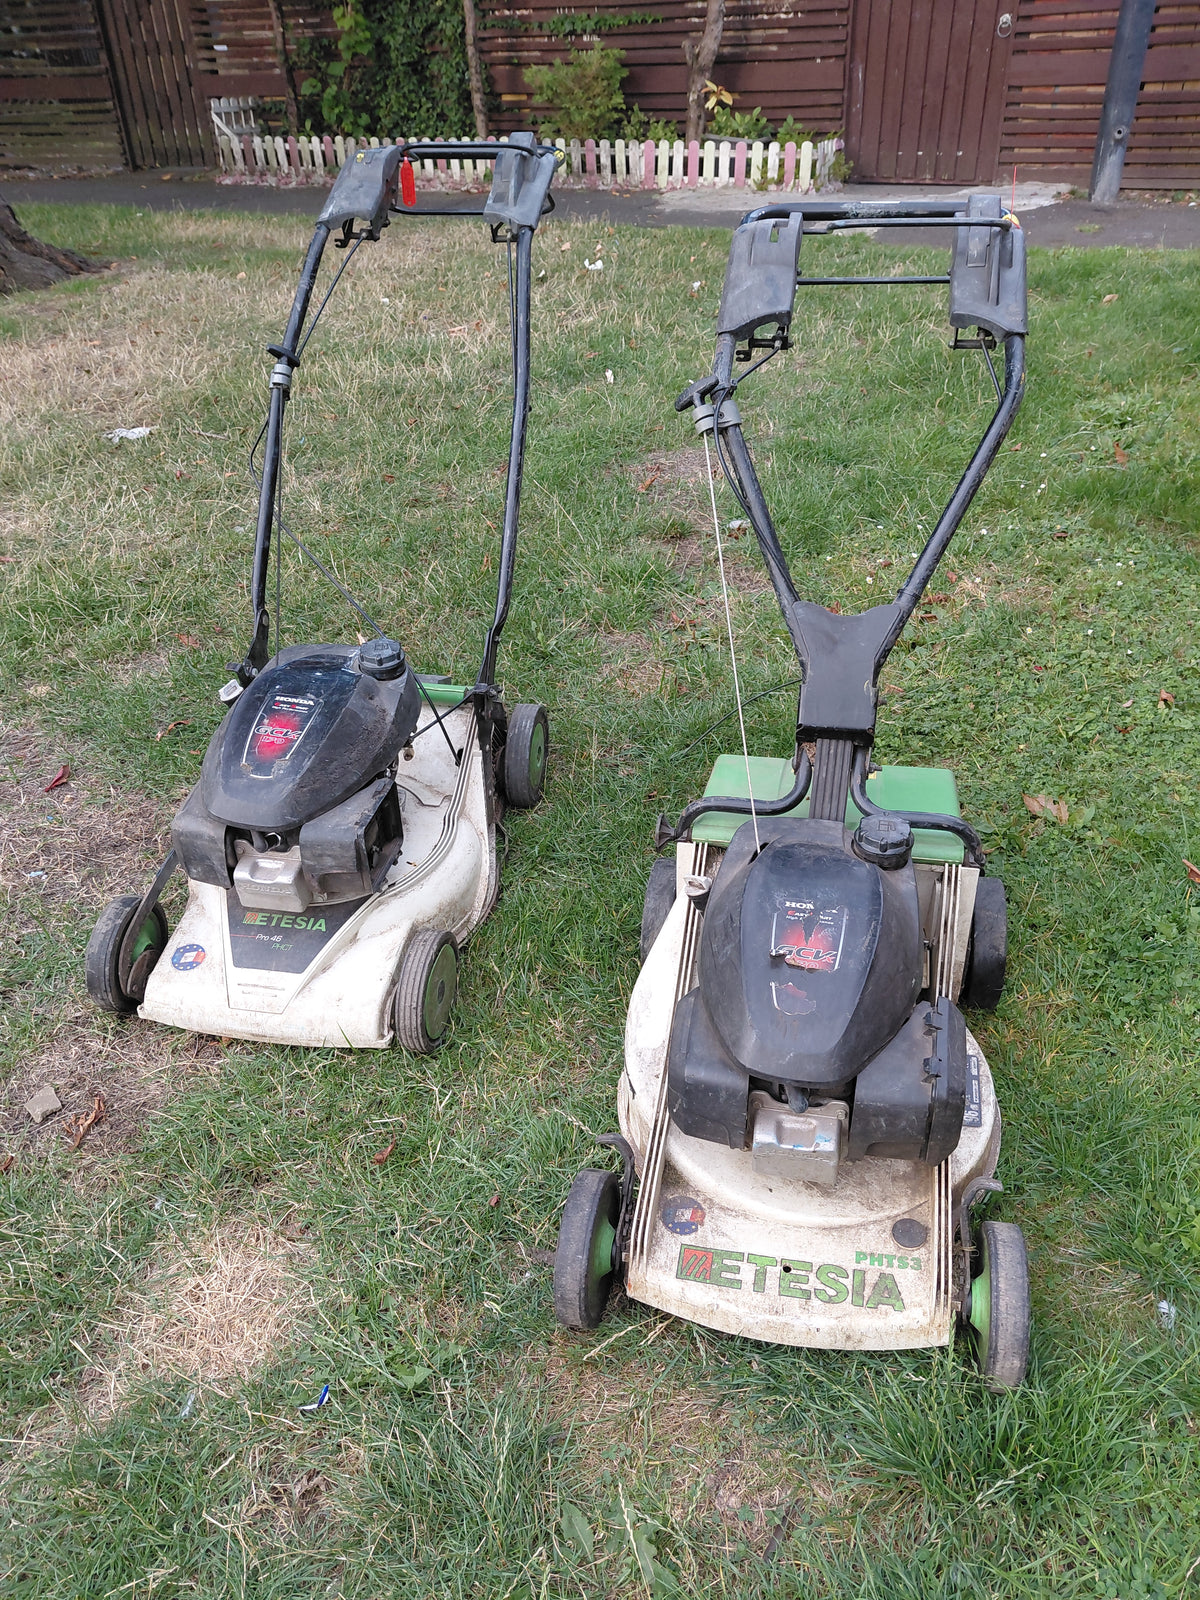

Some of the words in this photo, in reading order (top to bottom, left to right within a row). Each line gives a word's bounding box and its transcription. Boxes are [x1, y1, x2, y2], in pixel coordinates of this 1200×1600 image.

[275, 695, 315, 706] HONDA
[254, 911, 326, 932] ETESIA
[855, 1251, 922, 1270] PHTS3
[706, 1248, 905, 1311] ETESIA
